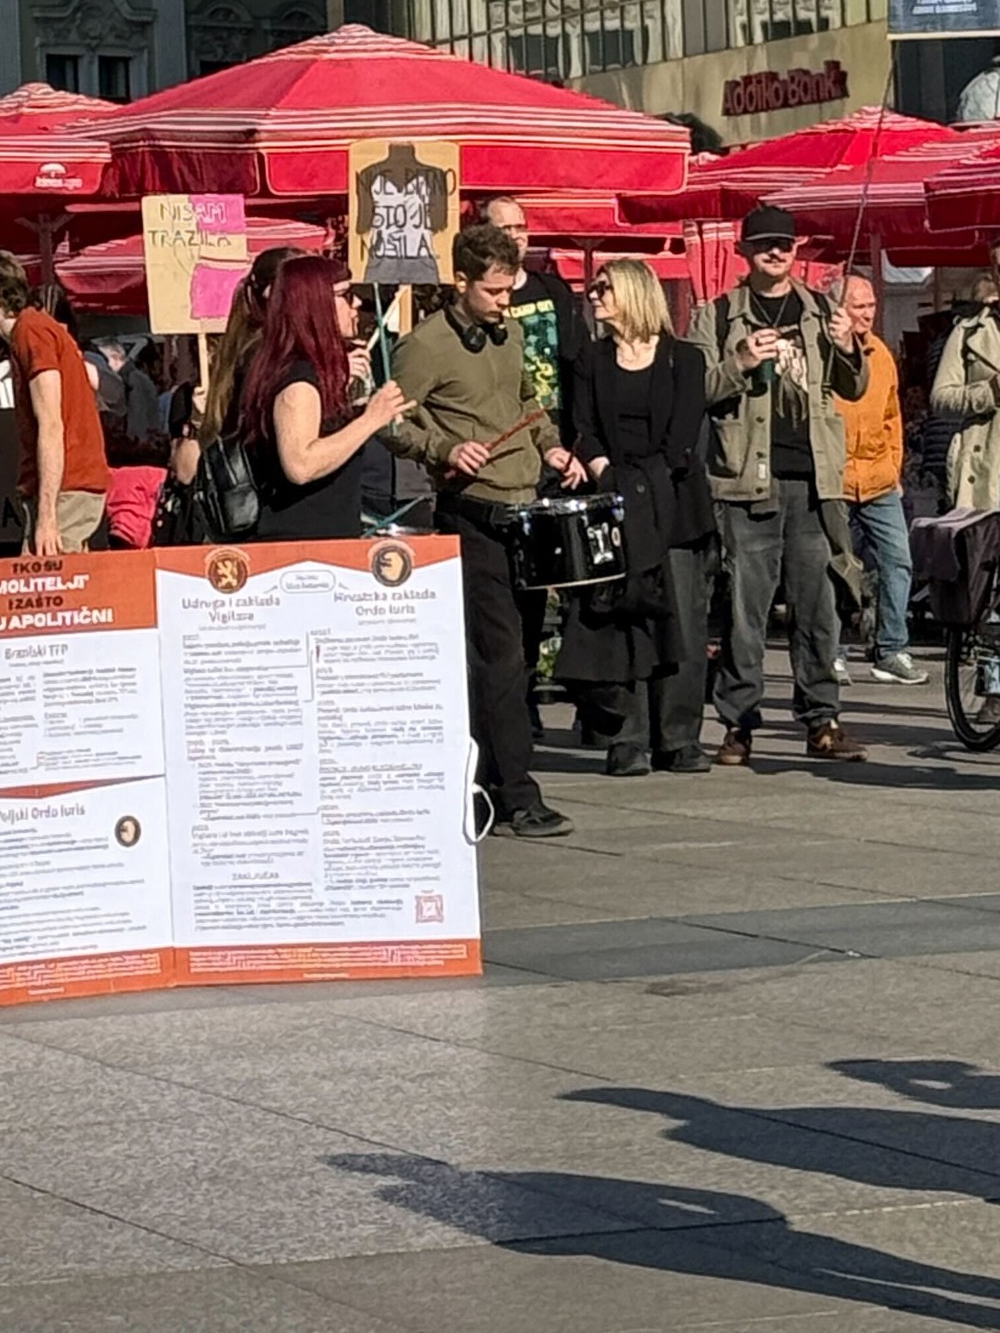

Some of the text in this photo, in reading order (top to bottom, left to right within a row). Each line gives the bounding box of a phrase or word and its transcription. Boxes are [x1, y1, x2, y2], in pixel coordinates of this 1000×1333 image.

[786, 65, 842, 106] Bank
[159, 203, 226, 222] NISAM
[8, 605, 115, 631] APOLITIČNI
